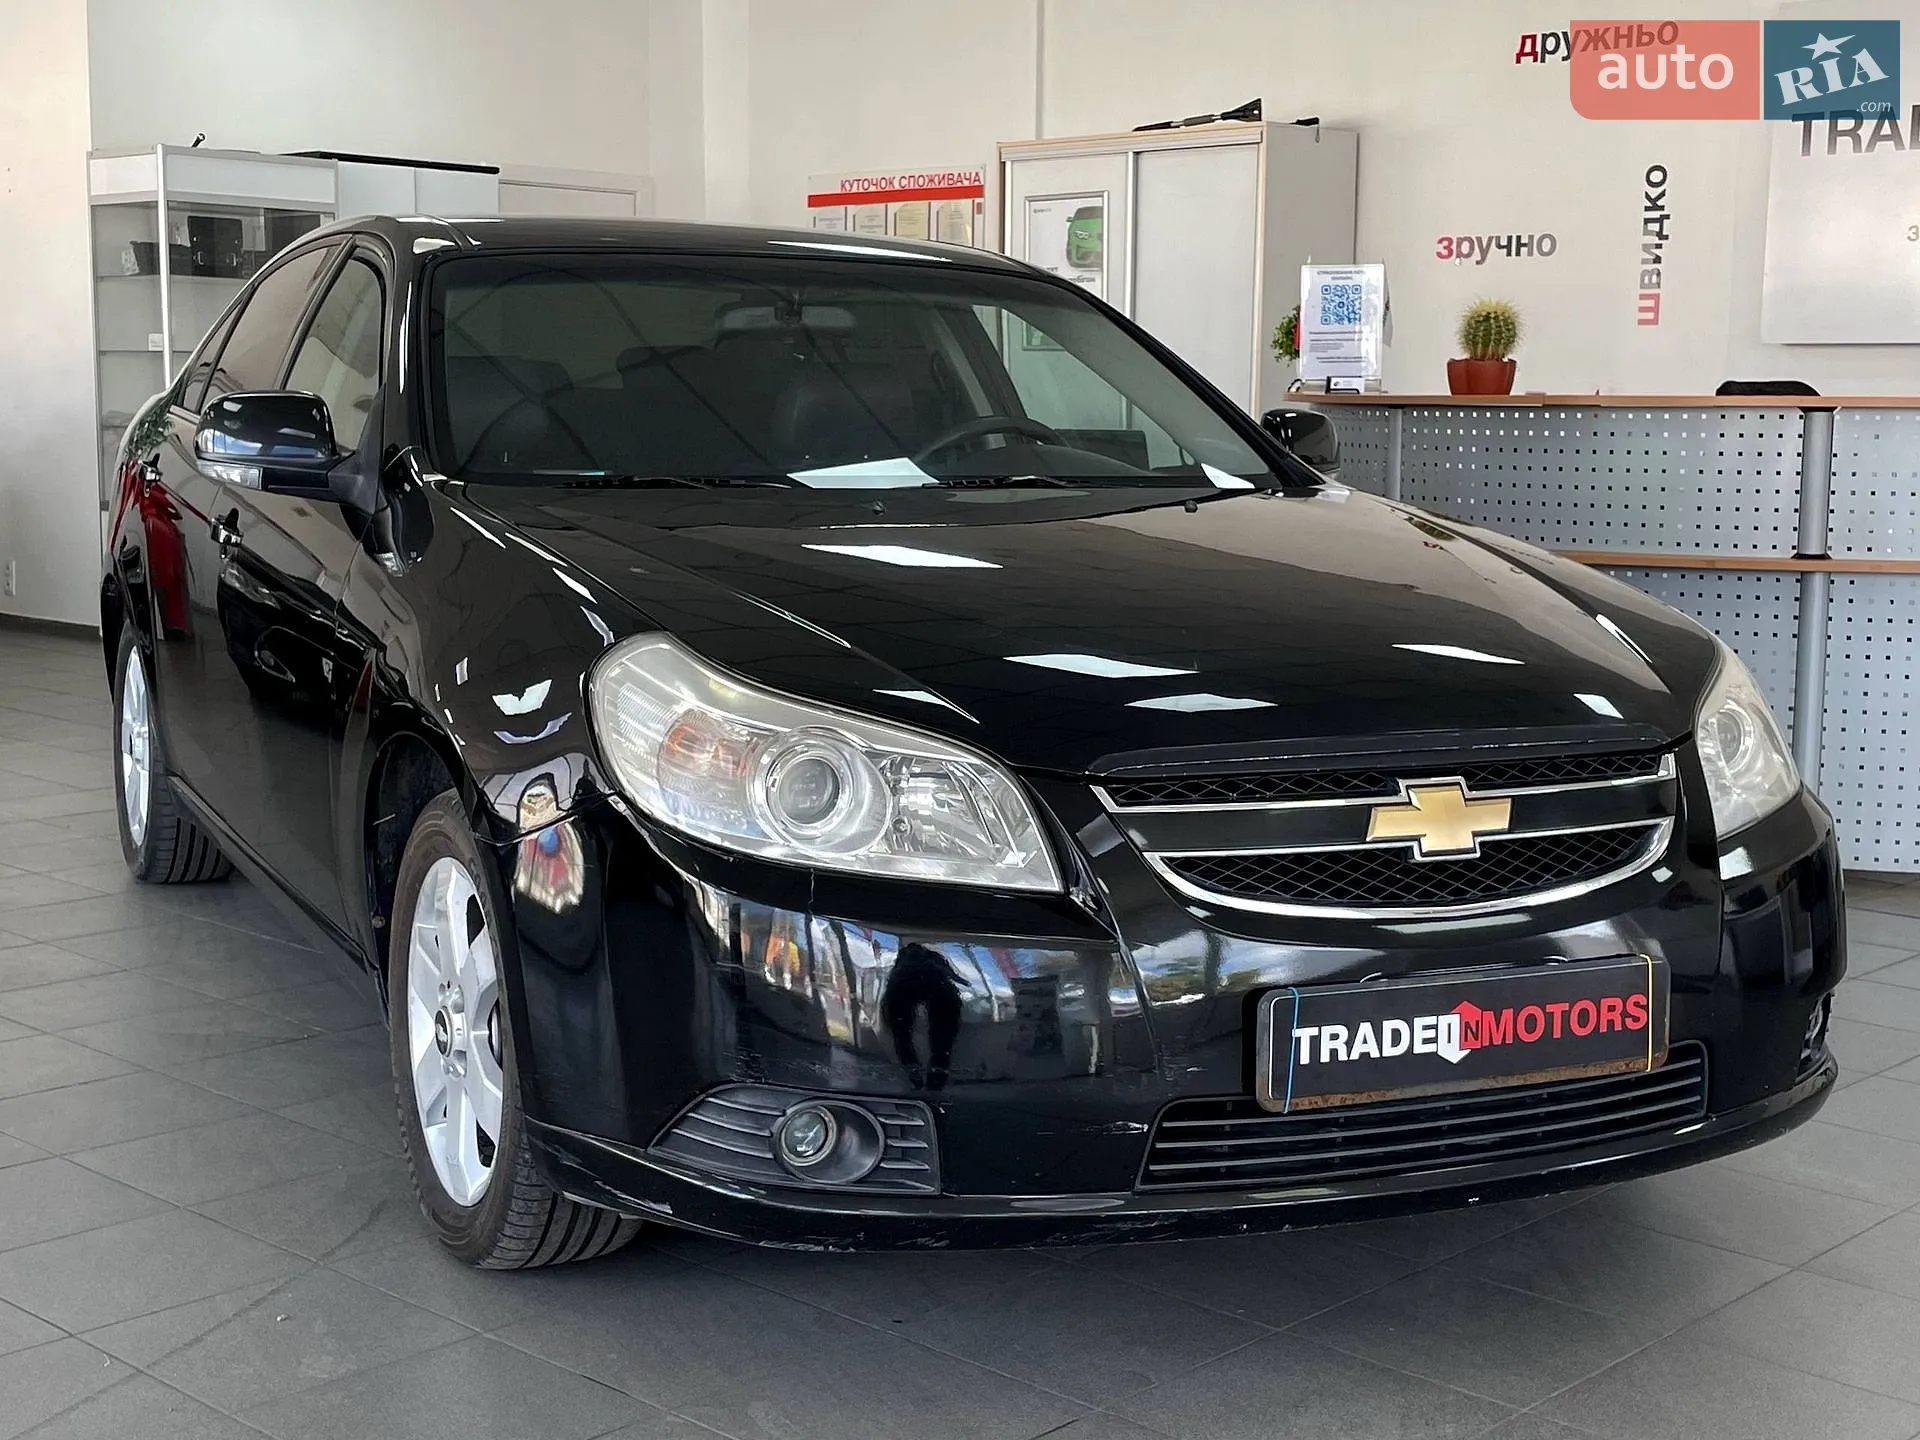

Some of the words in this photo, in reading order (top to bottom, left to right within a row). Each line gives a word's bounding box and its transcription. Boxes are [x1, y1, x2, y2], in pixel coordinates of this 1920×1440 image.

[1515, 20, 1680, 65] дружньо
[840, 177, 896, 193] КУТОЧОК
[898, 172, 983, 190] СПОЖИВАЧА
[1435, 232, 1558, 266] зручно
[1637, 164, 1671, 326] швидко
